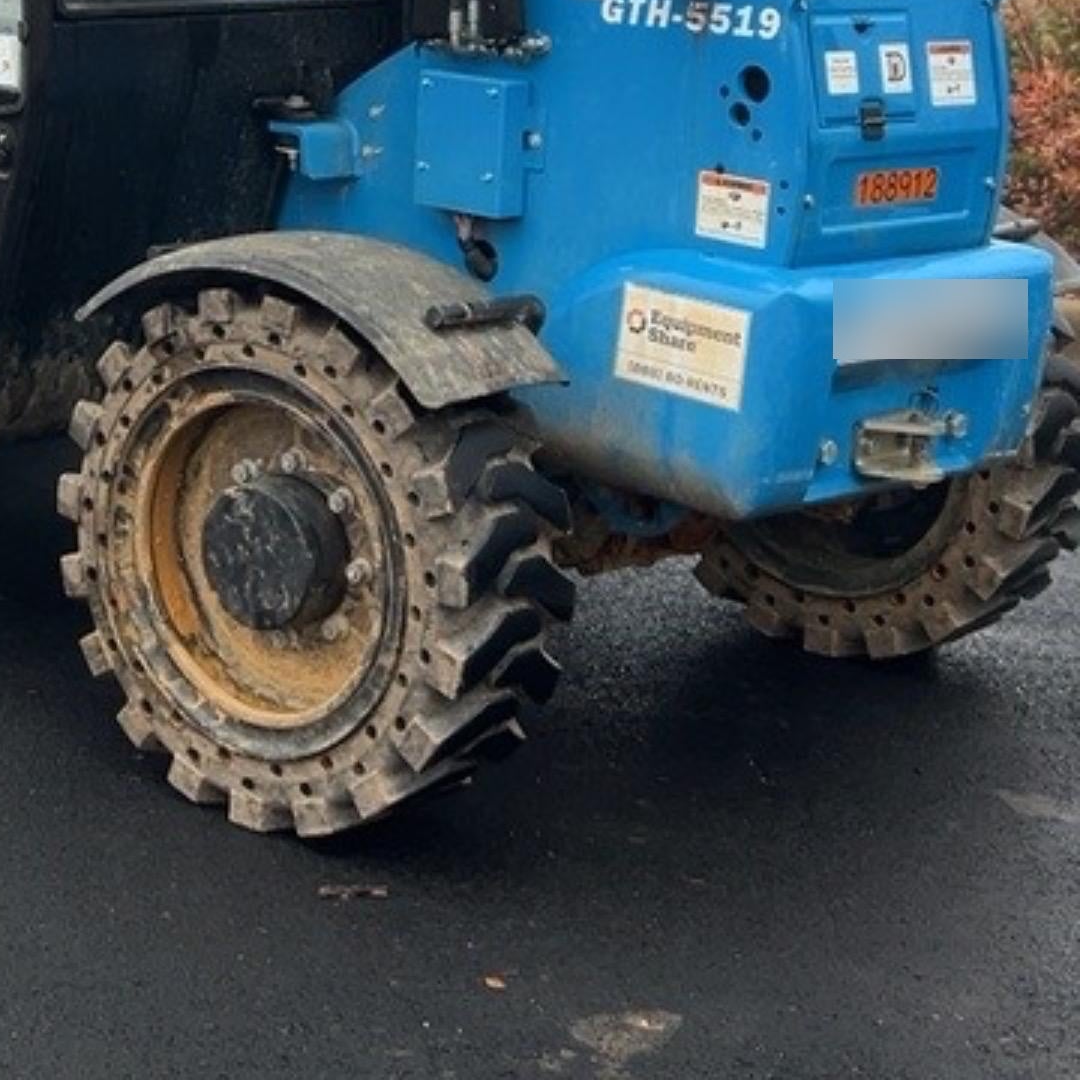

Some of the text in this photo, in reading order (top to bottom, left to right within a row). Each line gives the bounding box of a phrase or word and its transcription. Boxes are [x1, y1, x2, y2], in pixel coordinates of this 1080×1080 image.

[858, 168, 938, 205] 188912
[646, 325, 698, 354] Share
[649, 307, 742, 348] Equipment
